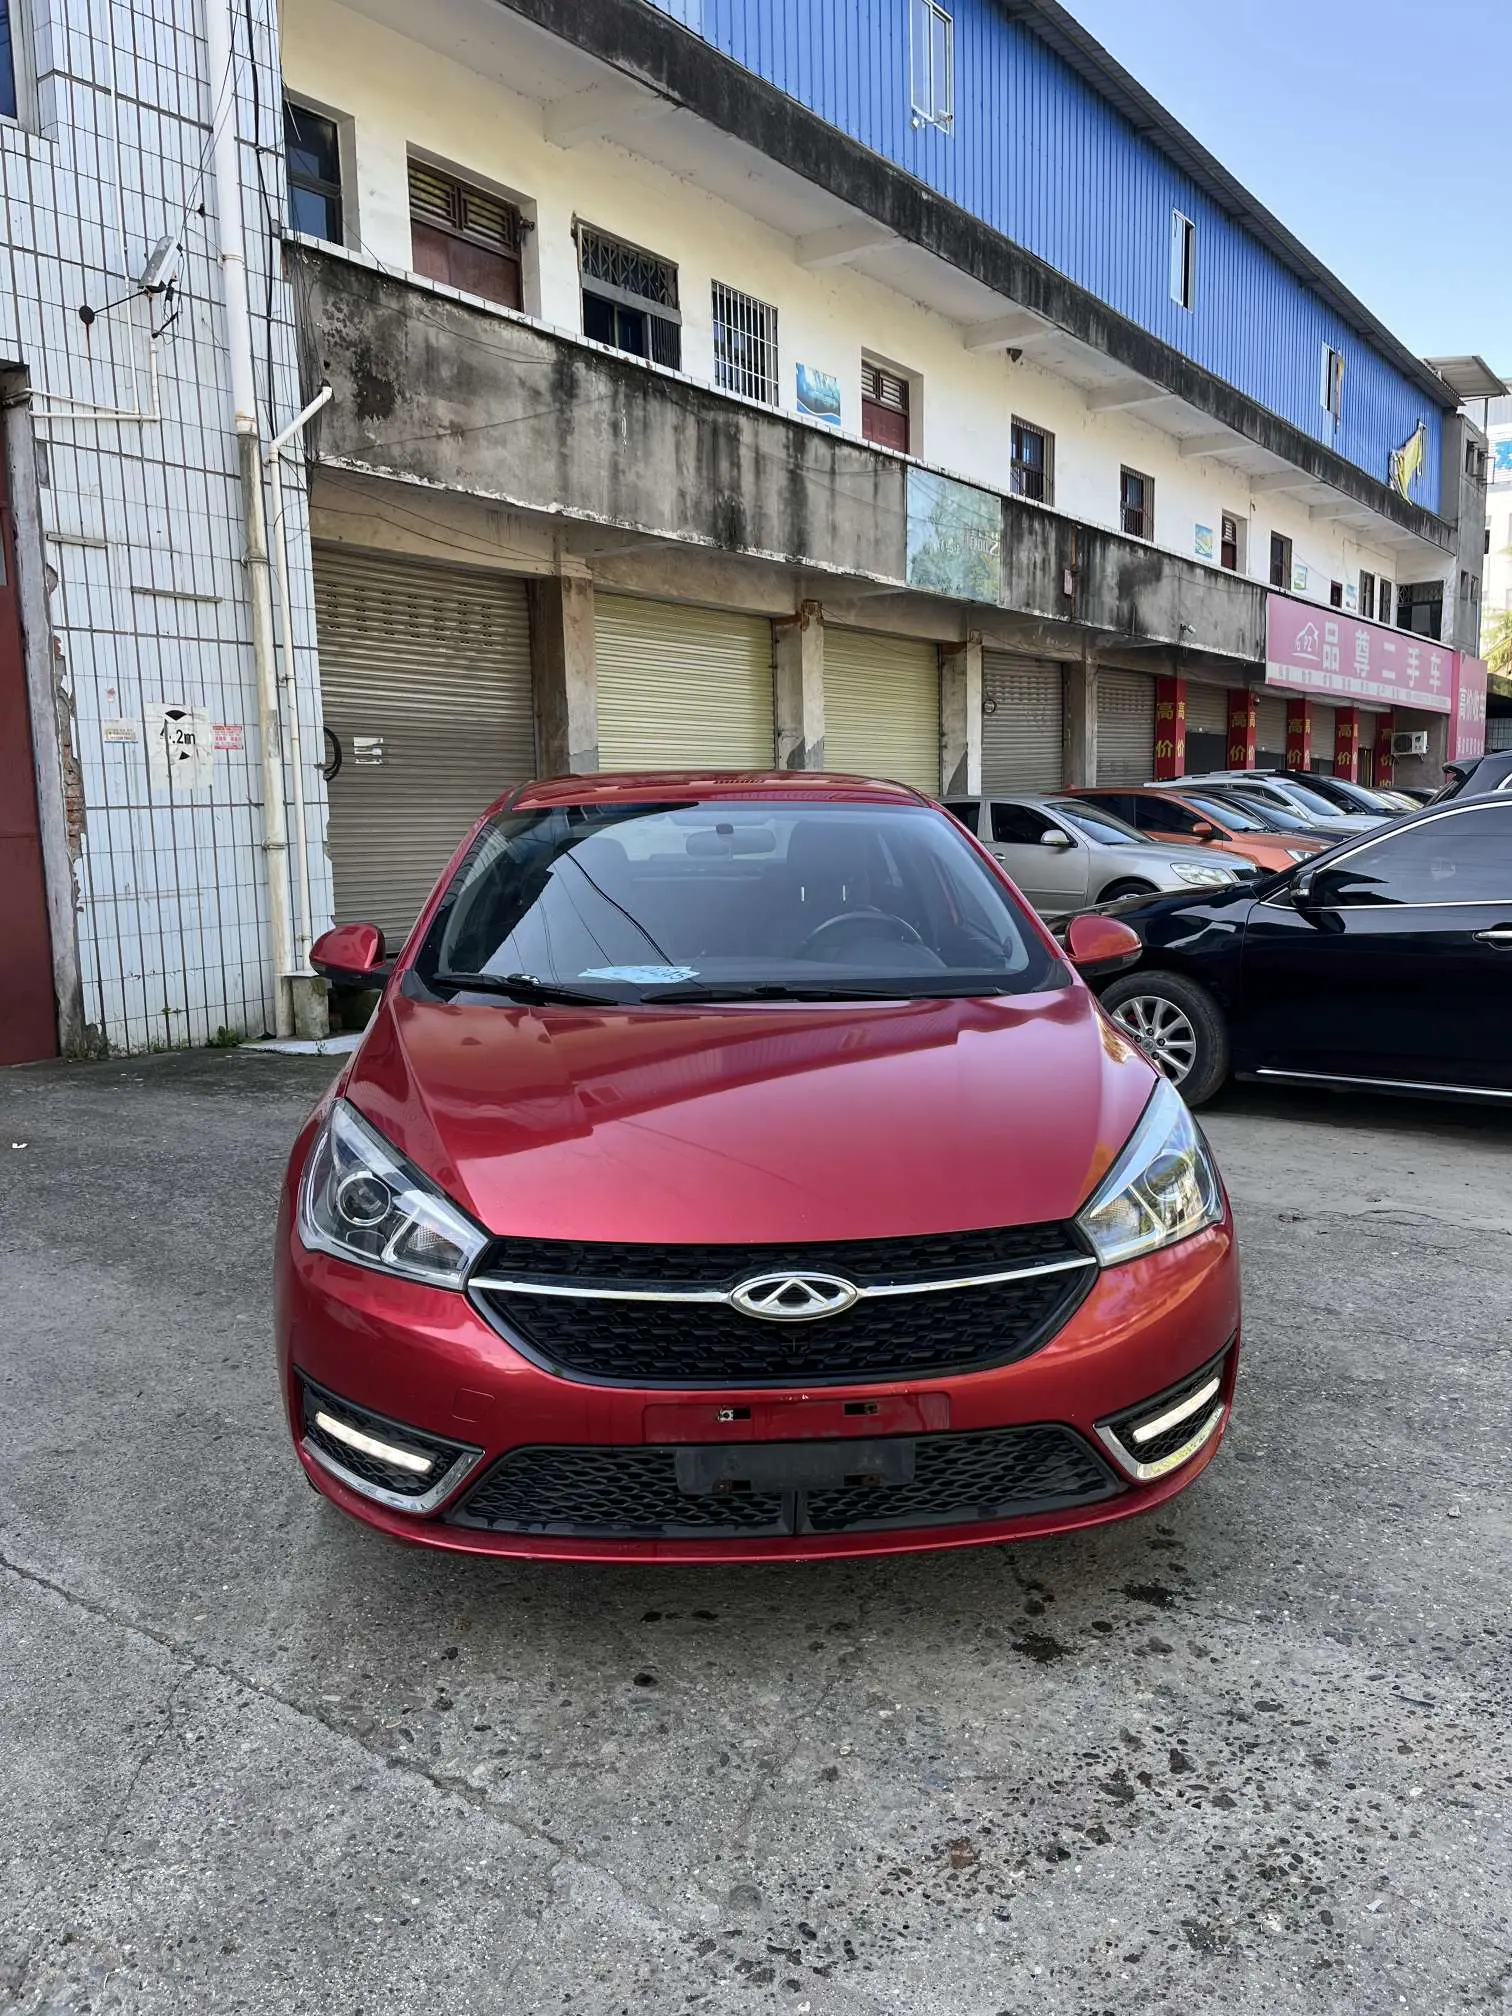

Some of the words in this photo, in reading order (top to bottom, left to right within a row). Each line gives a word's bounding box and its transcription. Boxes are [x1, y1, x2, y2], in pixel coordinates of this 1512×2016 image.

[1322, 620, 1442, 694] 品尊二手车
